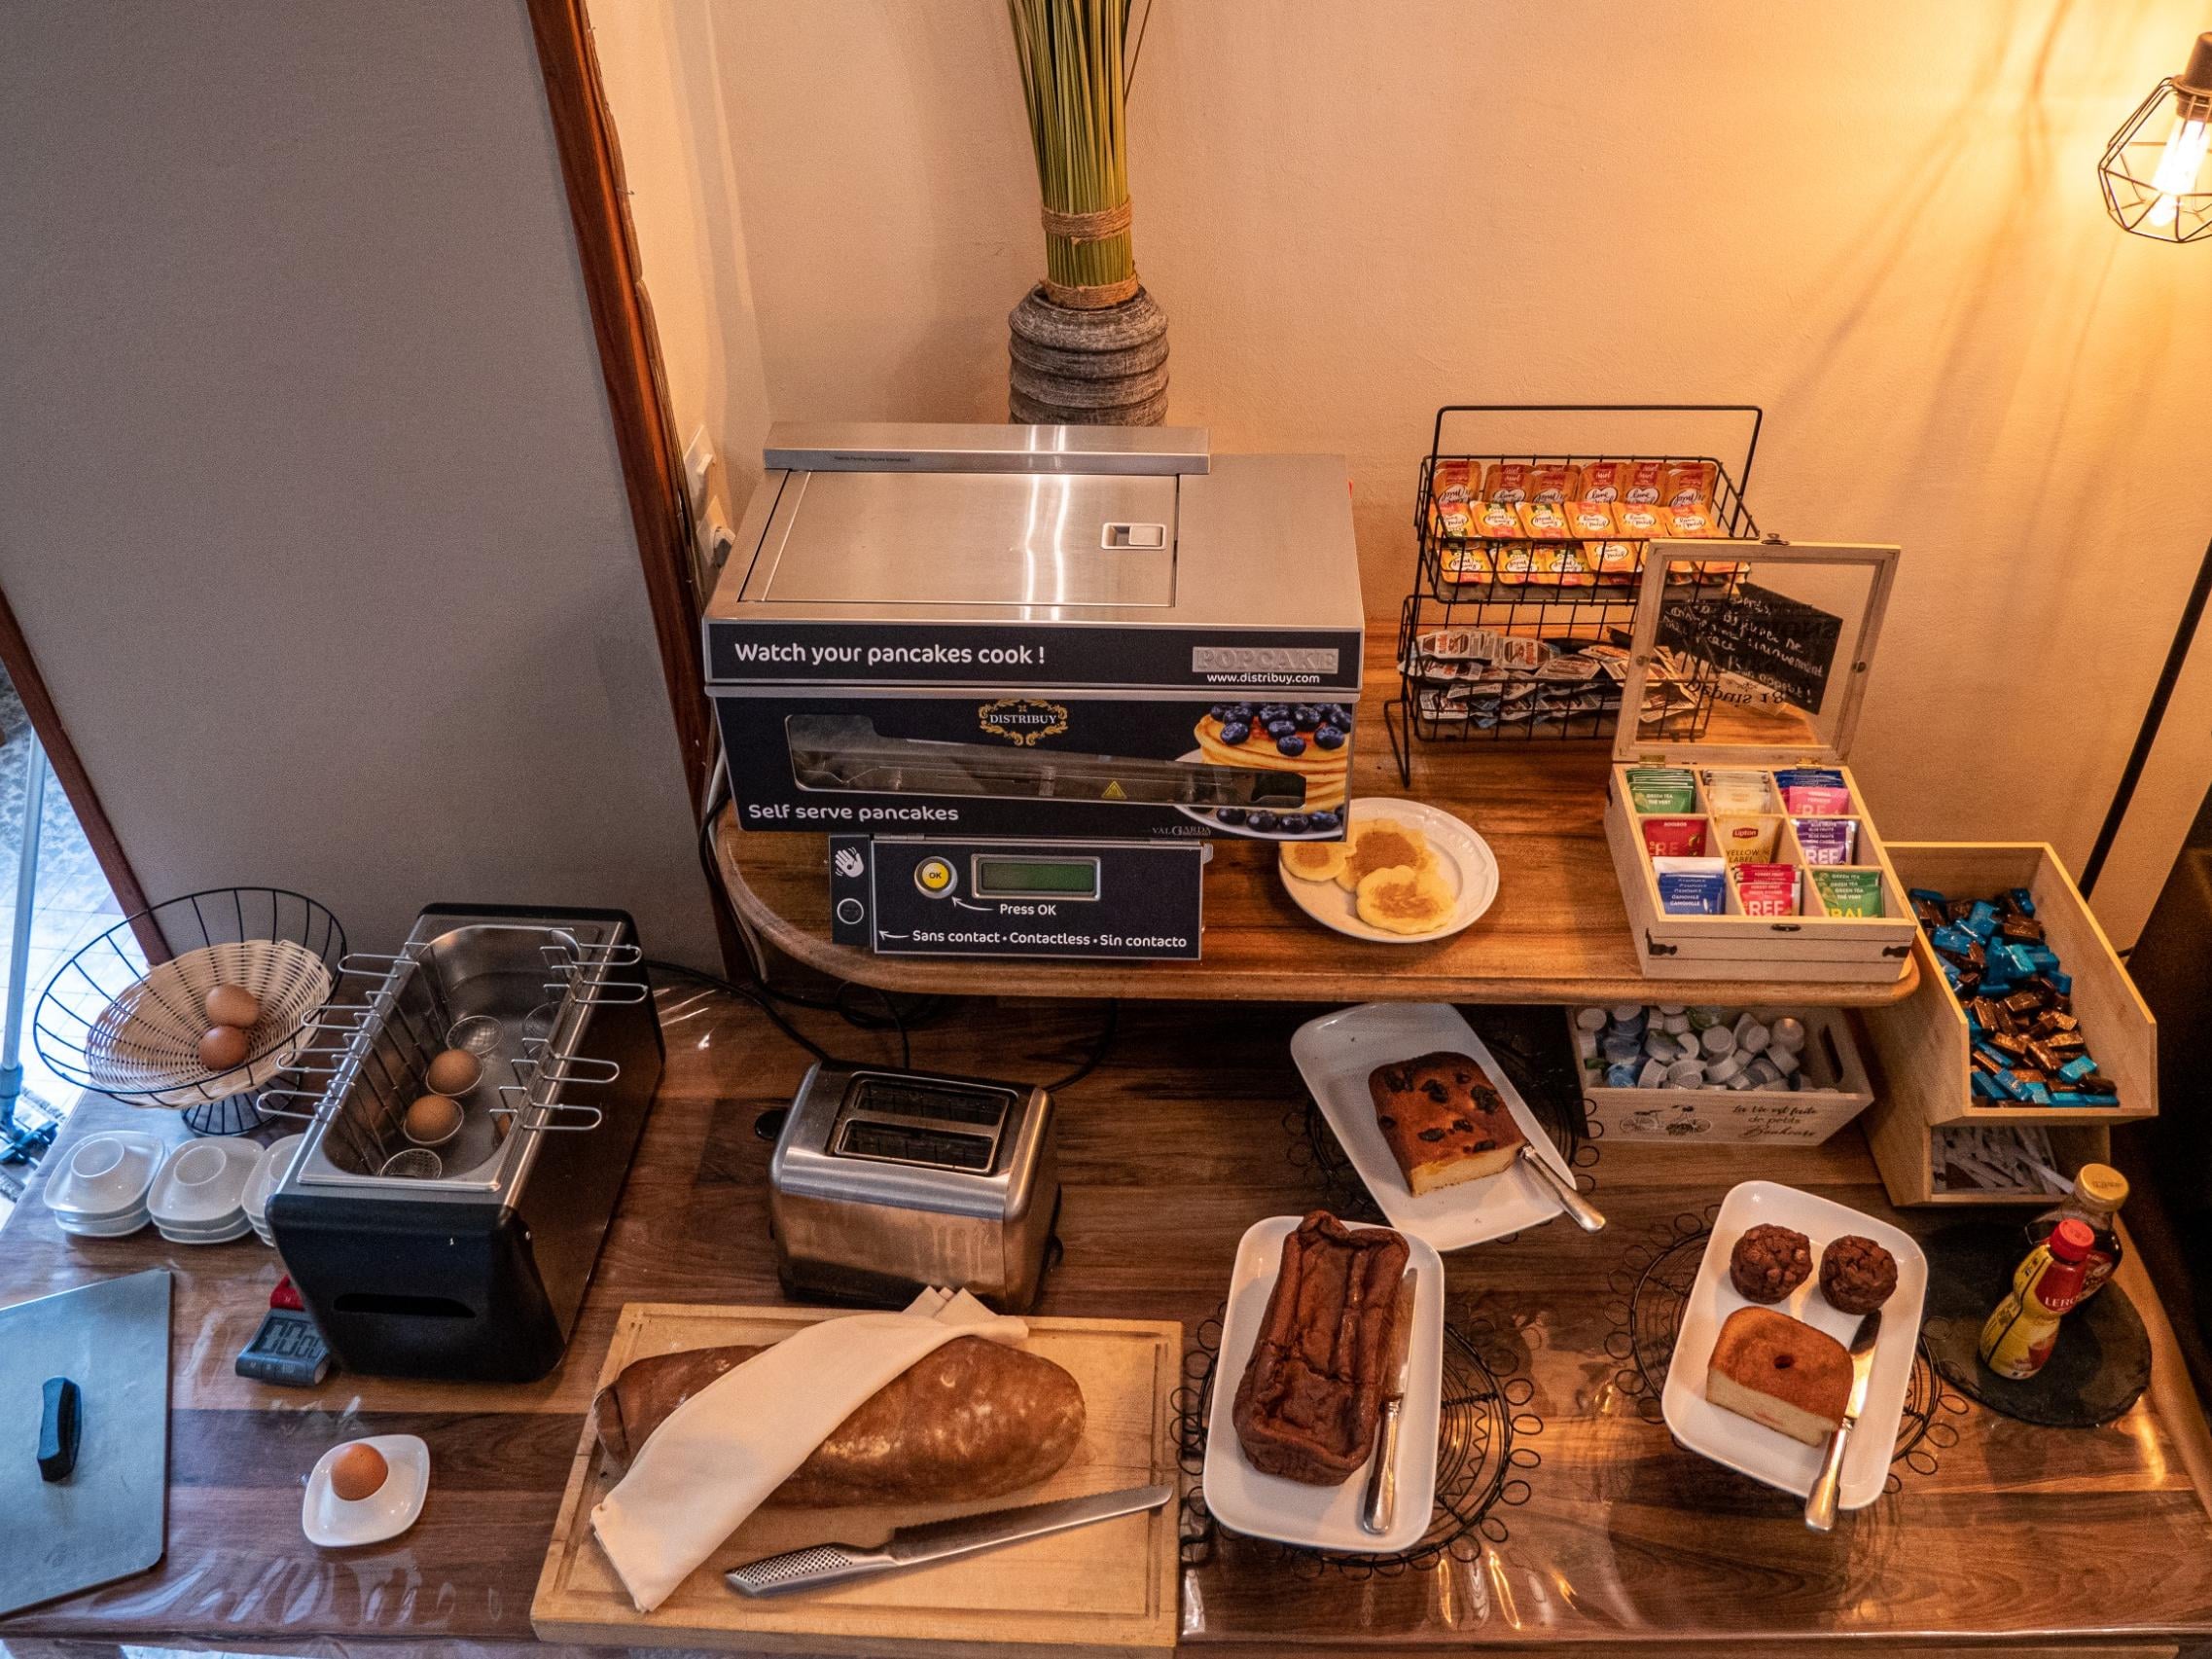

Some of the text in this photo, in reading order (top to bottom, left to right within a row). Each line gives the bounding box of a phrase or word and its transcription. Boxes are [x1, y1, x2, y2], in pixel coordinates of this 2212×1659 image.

[734, 643, 1045, 666] Watch your pancakes cook !
[1195, 649, 1337, 671] POPCAKE
[1207, 672, 1320, 684] www.distribuy.com
[990, 714, 1056, 724] DISTRIBUY
[748, 804, 959, 822] Self serve pancakes
[929, 871, 942, 880] OK
[1000, 903, 1056, 916] Press OK
[912, 929, 1187, 948] Sans contact Contactless Sin contacto
